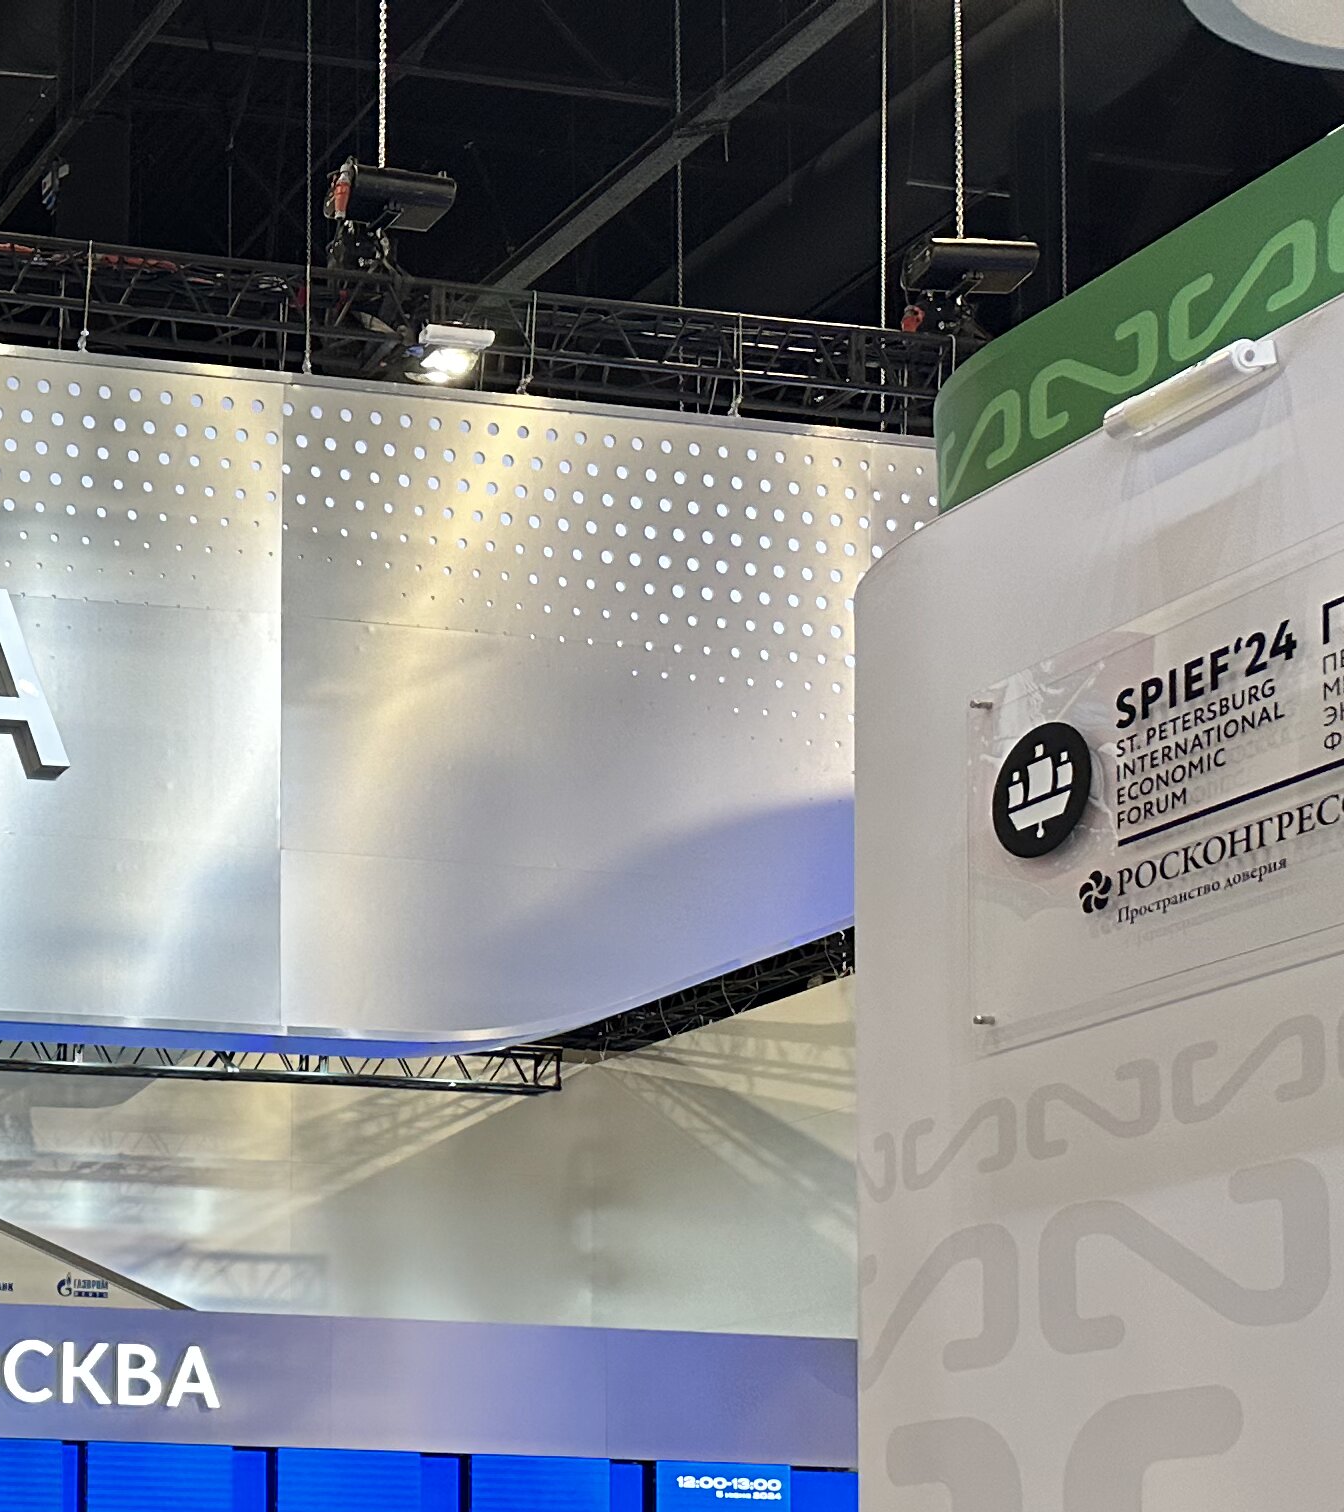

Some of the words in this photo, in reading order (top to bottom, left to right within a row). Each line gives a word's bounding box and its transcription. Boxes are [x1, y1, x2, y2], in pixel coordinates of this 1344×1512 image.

[1115, 619, 1298, 729] SPIEF'24
[1116, 735, 1142, 758] ST.
[1146, 678, 1276, 746] PETERSBURG
[1116, 702, 1285, 782] INTERNATIONAL
[1117, 748, 1227, 806] ECONOMIC
[1117, 788, 1187, 830] FORUM
[1117, 793, 1344, 897] РОСКОНГРЕС
[1117, 881, 1221, 924] Пространство
[1224, 858, 1288, 890] доверия
[676, 1475, 782, 1491] 12:00-13:00
